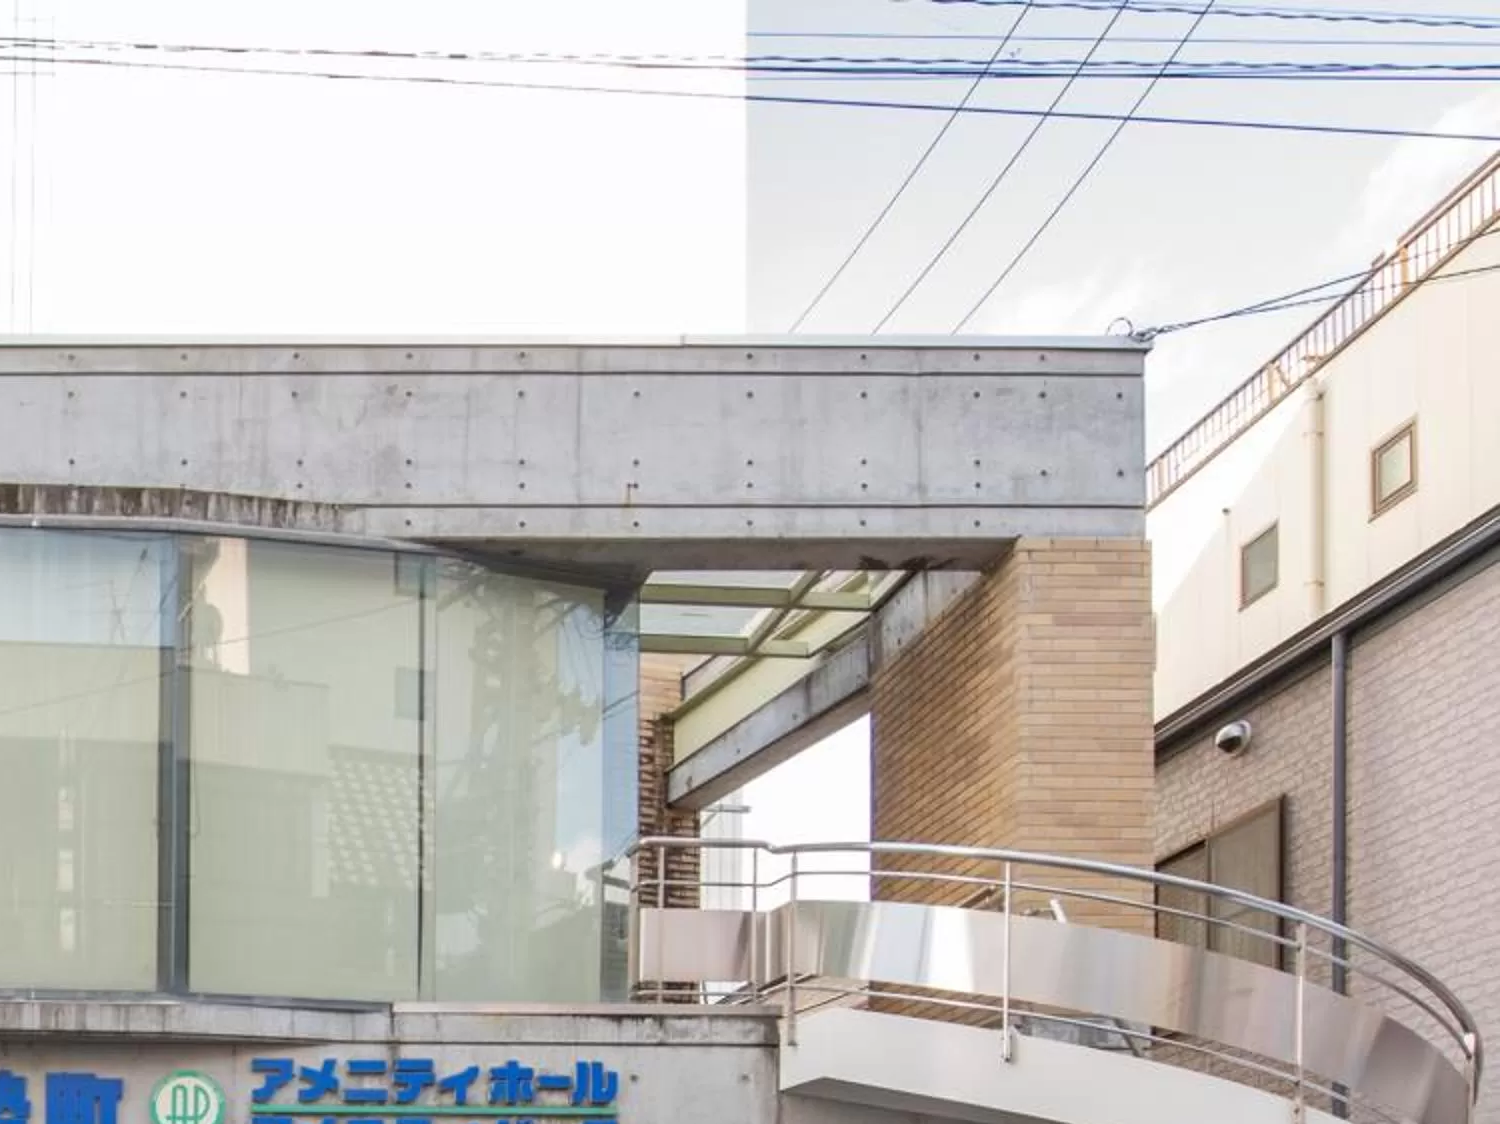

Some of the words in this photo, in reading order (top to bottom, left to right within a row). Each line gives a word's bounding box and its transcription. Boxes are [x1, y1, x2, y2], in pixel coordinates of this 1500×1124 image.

[251, 1057, 618, 1105] アメニティホール
